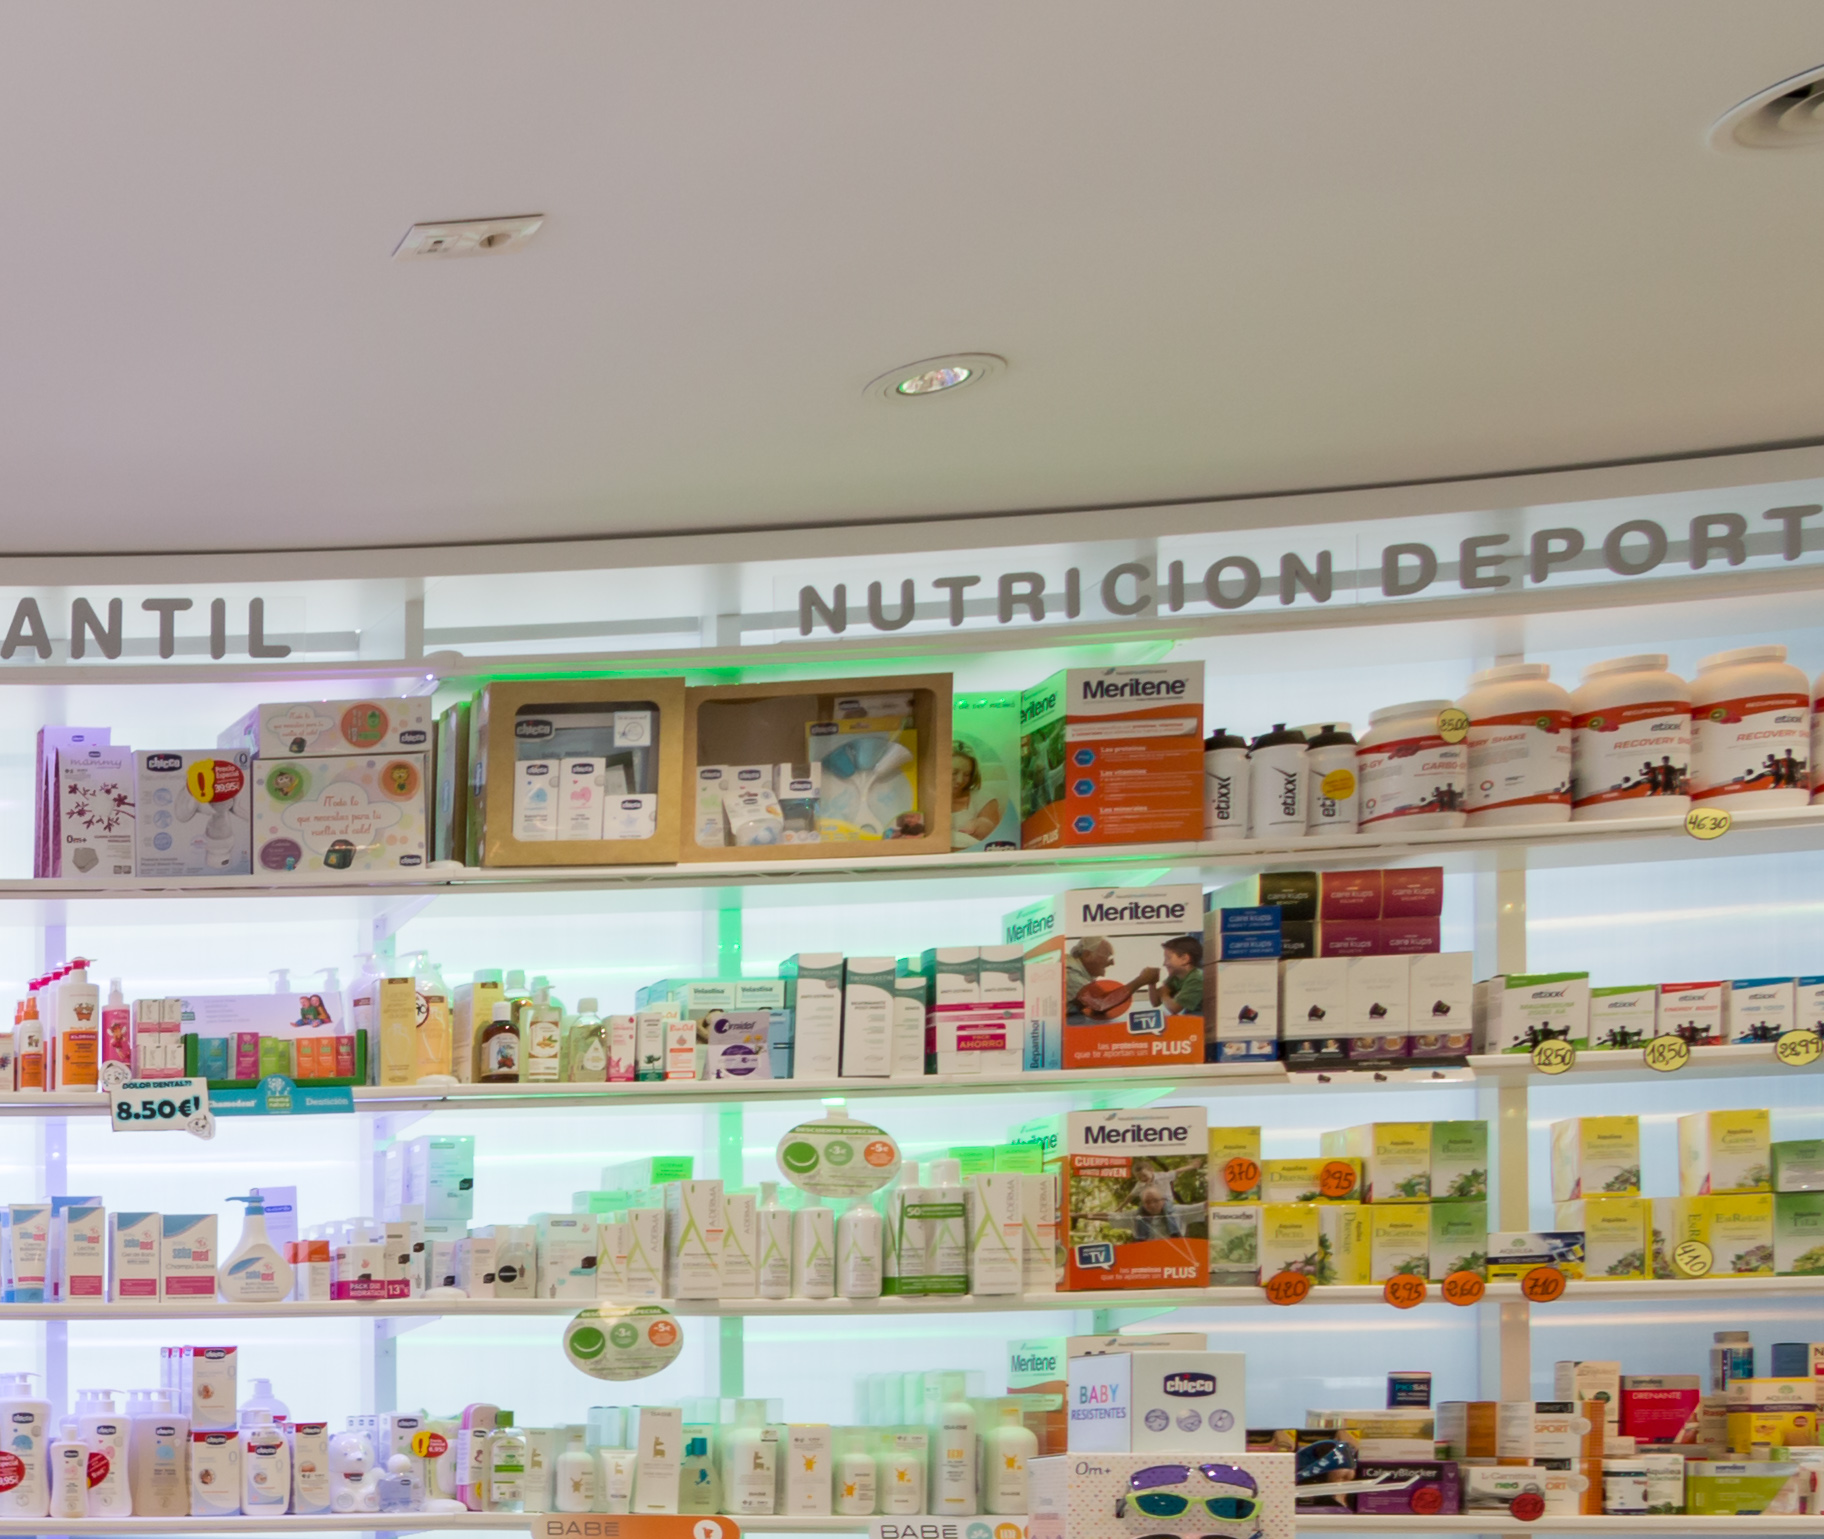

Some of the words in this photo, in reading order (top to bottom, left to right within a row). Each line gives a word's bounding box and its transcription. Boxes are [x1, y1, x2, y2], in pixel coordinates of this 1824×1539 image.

[798, 549, 1333, 637] NUTRICION
[1082, 674, 1187, 702] Meritene
[1083, 902, 1185, 922] Meritene
[1152, 1040, 1191, 1055] PLUS
[1083, 1122, 1188, 1146] Meritene
[1079, 1383, 1119, 1404] BABY
[1071, 1407, 1126, 1421] RESISTENTES
